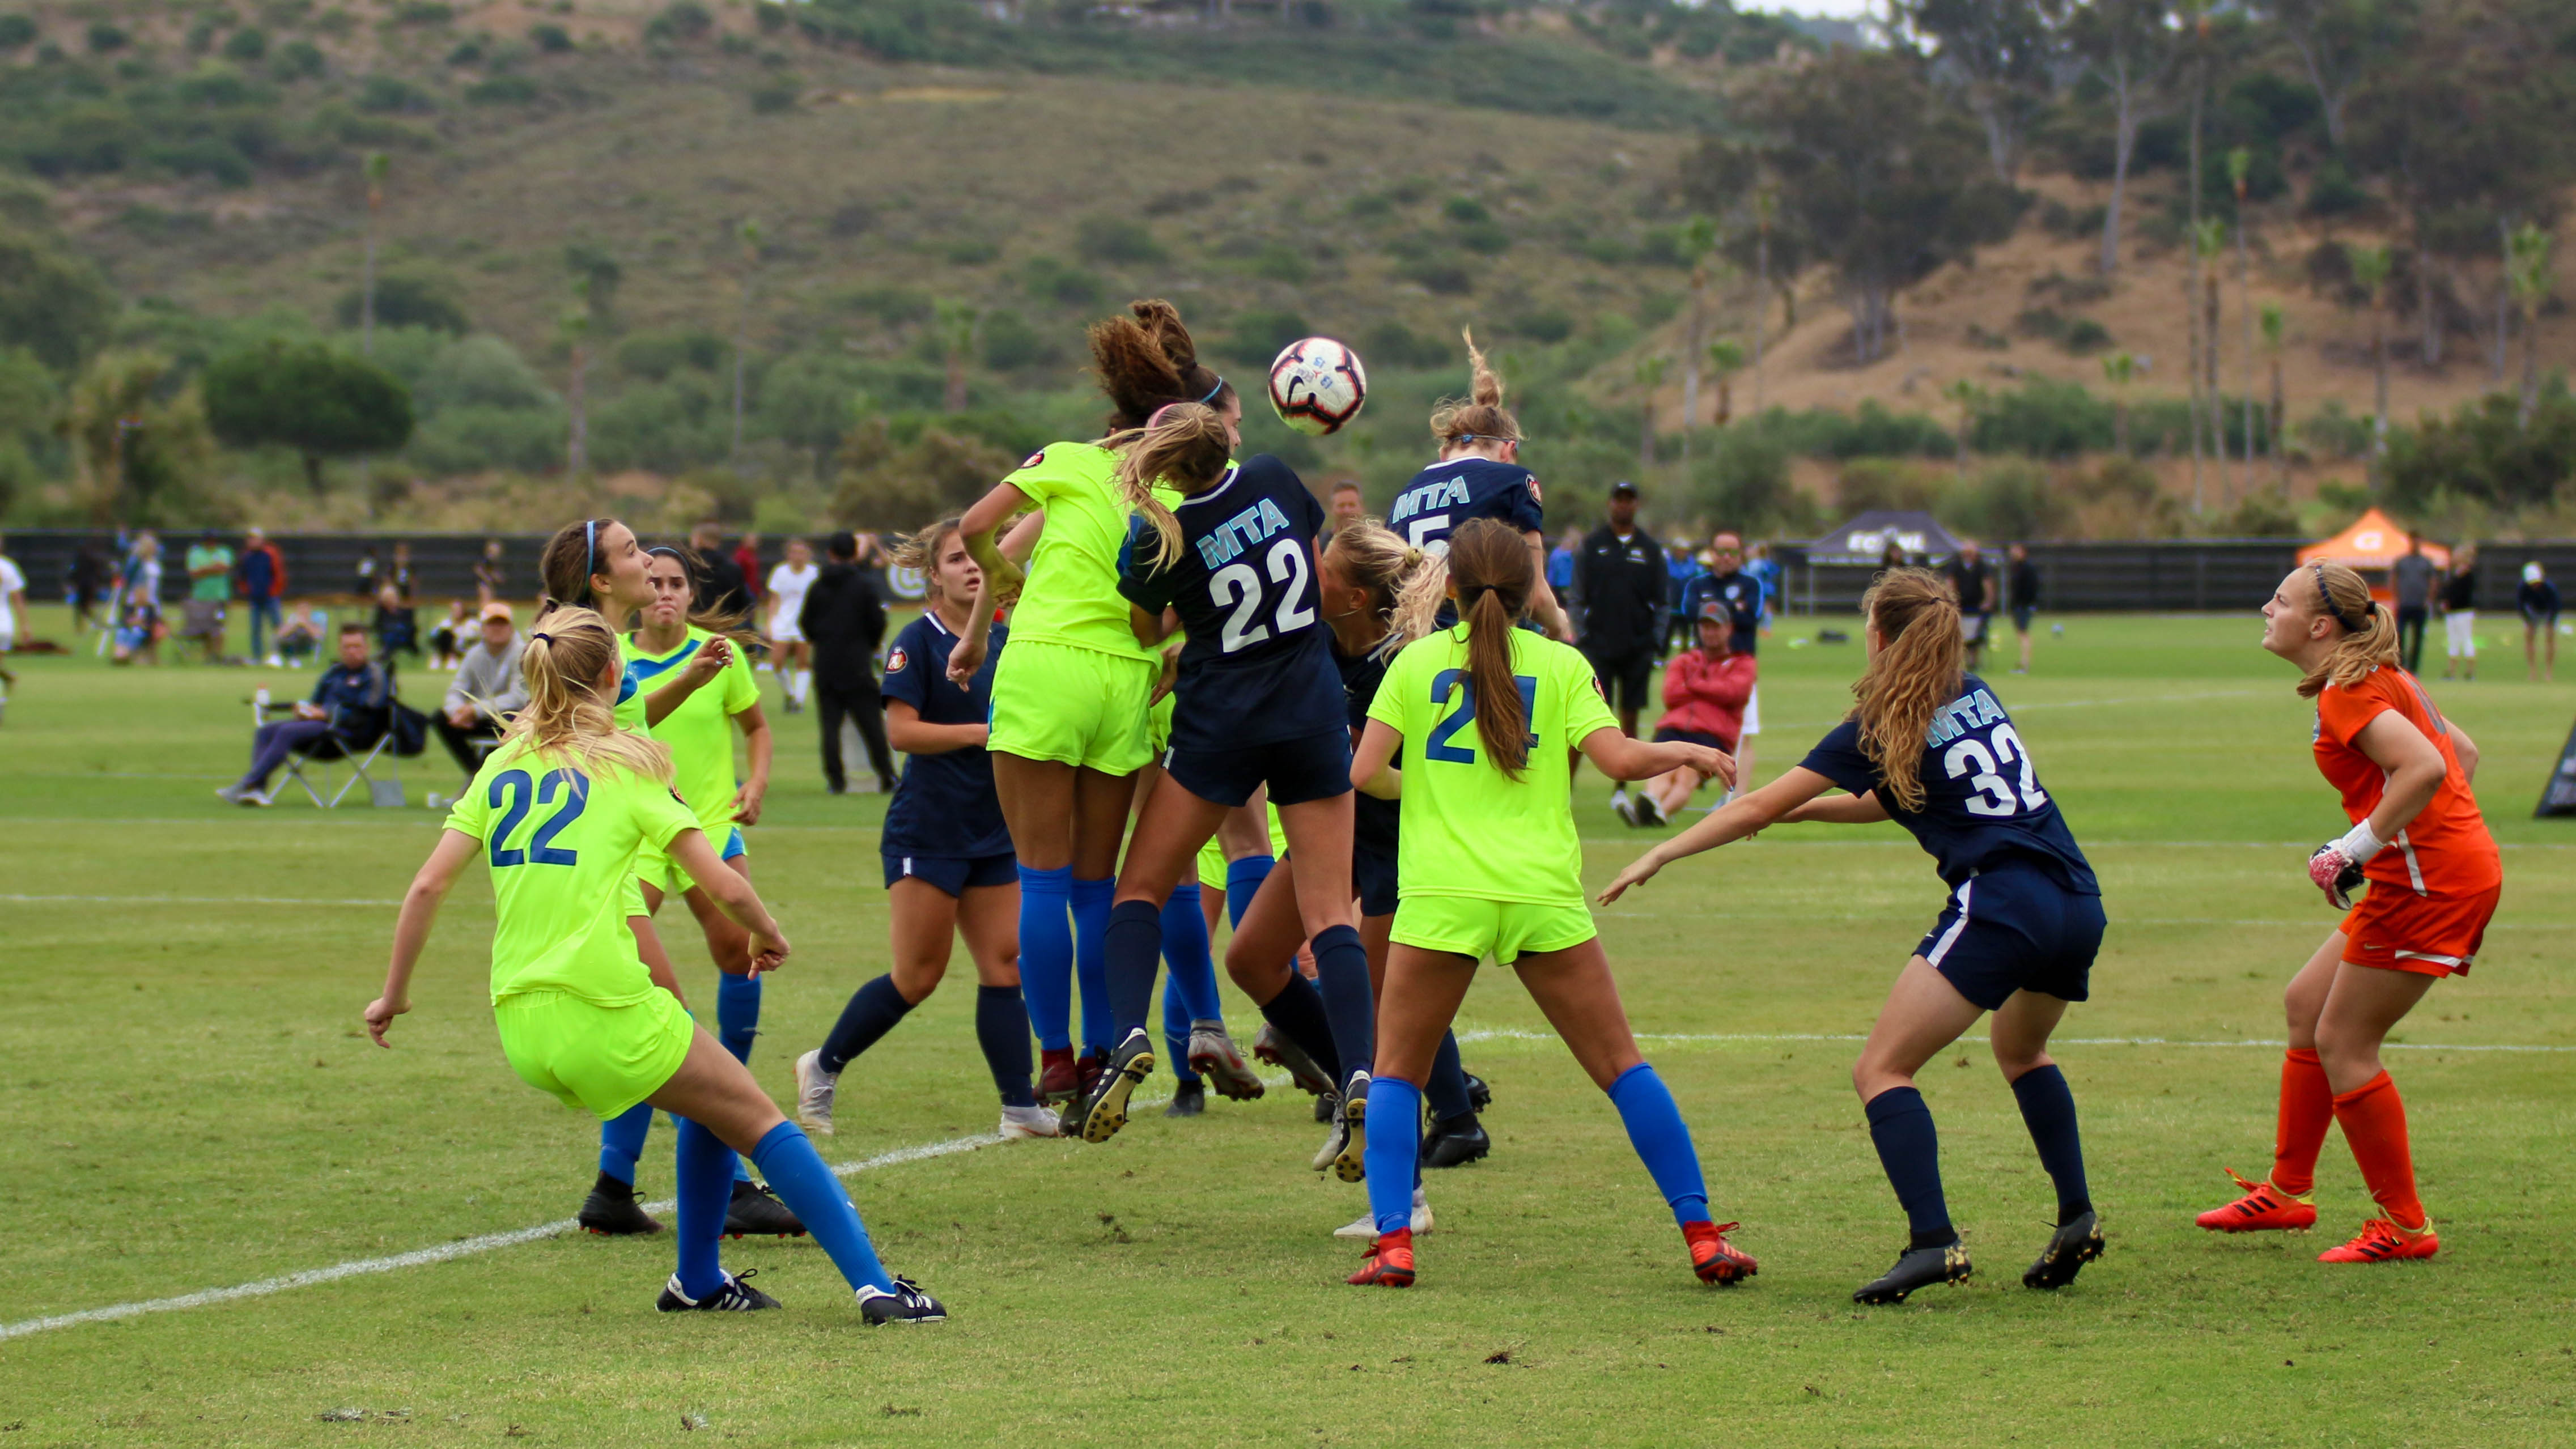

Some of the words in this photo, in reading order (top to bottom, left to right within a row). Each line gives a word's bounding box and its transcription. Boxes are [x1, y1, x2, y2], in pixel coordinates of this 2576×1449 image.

[1196, 498, 1289, 570] MTA
[1392, 475, 1470, 524] MTA
[1209, 538, 1315, 653] 22
[1925, 689, 2005, 748] MTA
[1944, 723, 2048, 816] 32
[489, 768, 589, 867] 22
